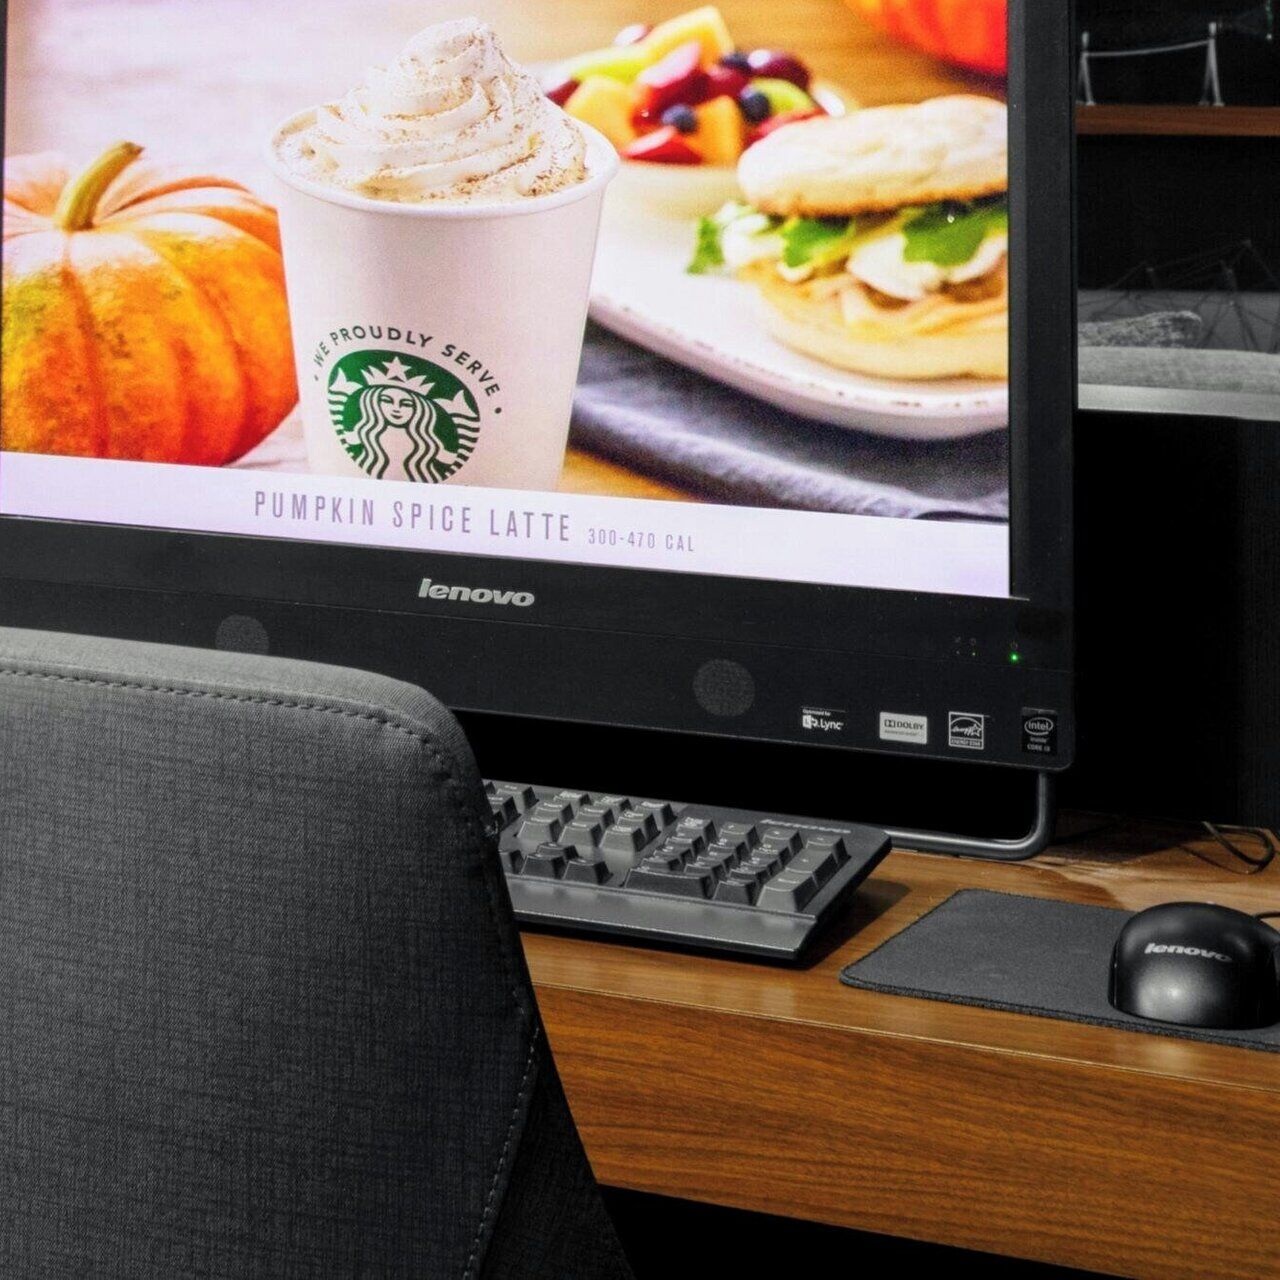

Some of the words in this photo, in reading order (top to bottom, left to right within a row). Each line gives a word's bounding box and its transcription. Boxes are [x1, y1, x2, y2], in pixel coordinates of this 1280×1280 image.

[312, 341, 331, 368] WE
[329, 324, 434, 348] PROUDLY
[441, 343, 501, 398] SERVE
[254, 490, 374, 526] PUMPKIN
[392, 500, 472, 534] SPICE
[489, 509, 570, 542] LATTE
[588, 528, 656, 550] 300-470
[665, 534, 694, 552] CAL
[418, 578, 536, 607] lenovo
[896, 720, 924, 730] DOLBY
[1144, 942, 1233, 962] lenovo
